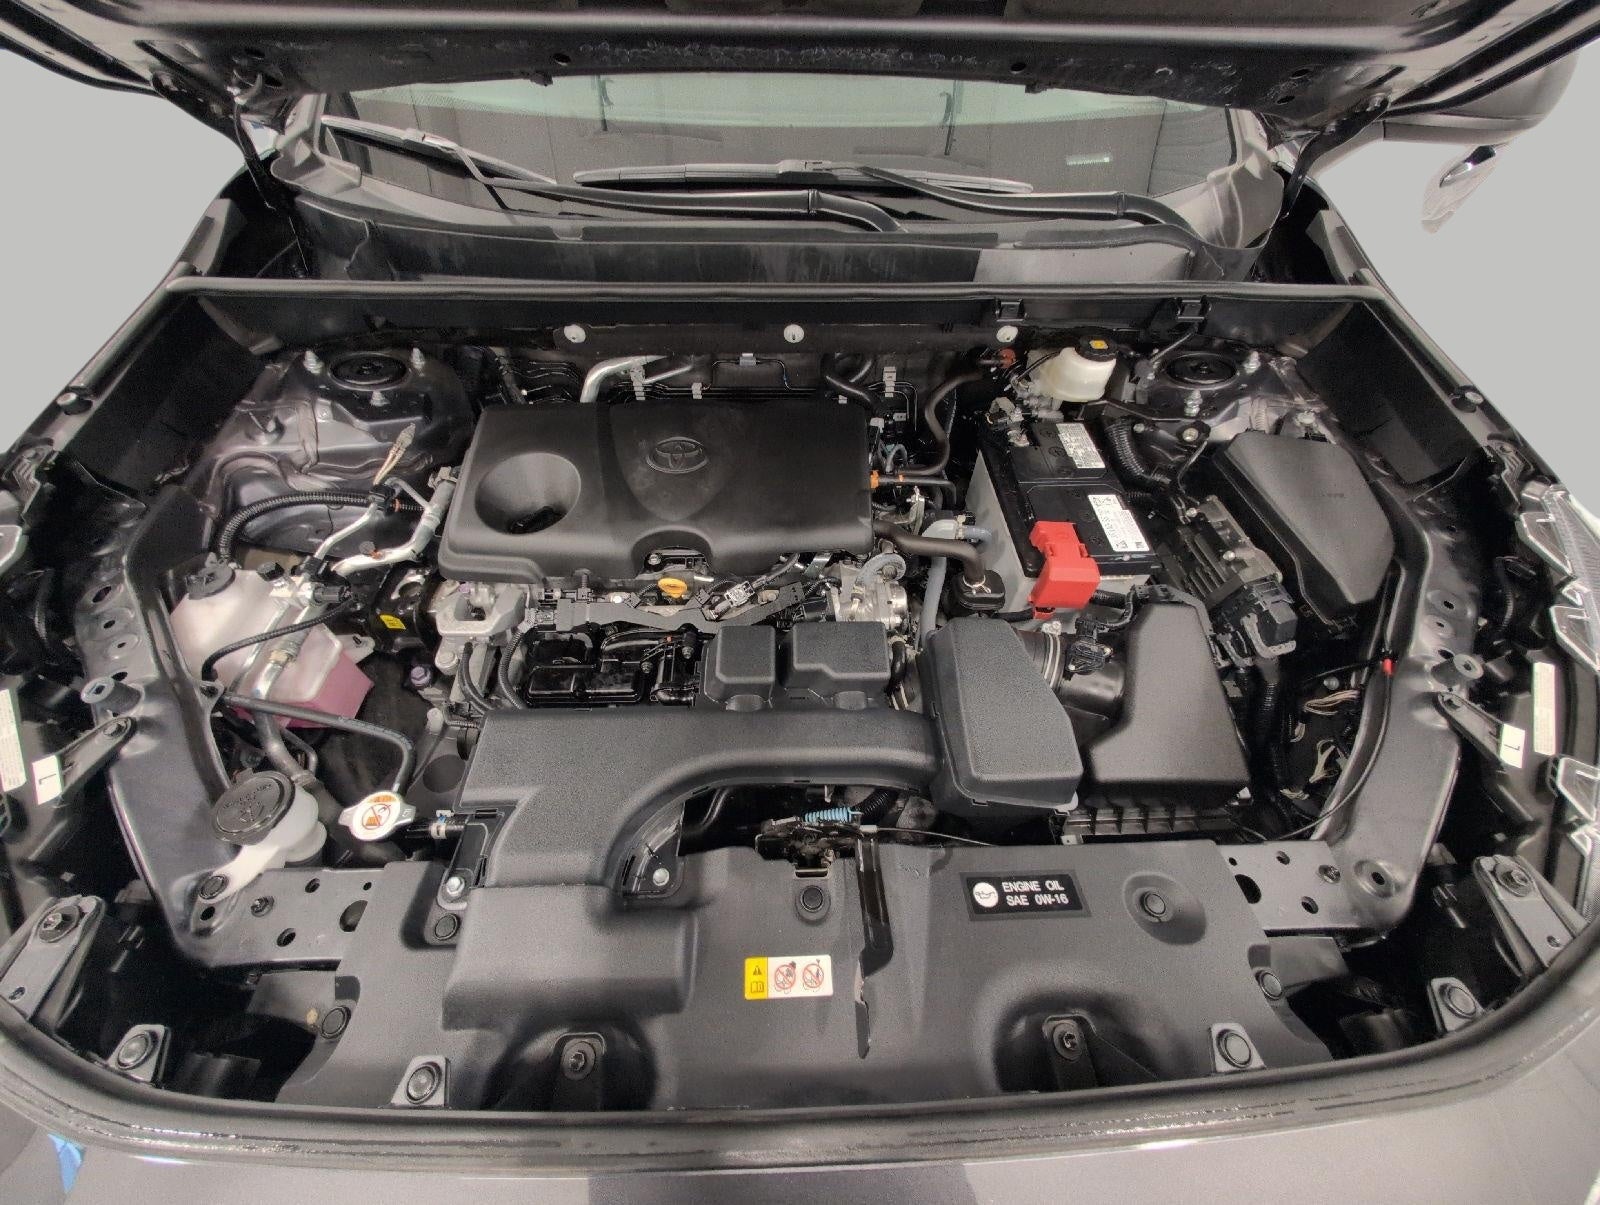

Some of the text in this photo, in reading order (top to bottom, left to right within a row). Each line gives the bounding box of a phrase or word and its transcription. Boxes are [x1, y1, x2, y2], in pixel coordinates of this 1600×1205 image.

[1002, 880, 1065, 893] ENGINE OIL
[1006, 893, 1069, 907] SAE 0W-16
